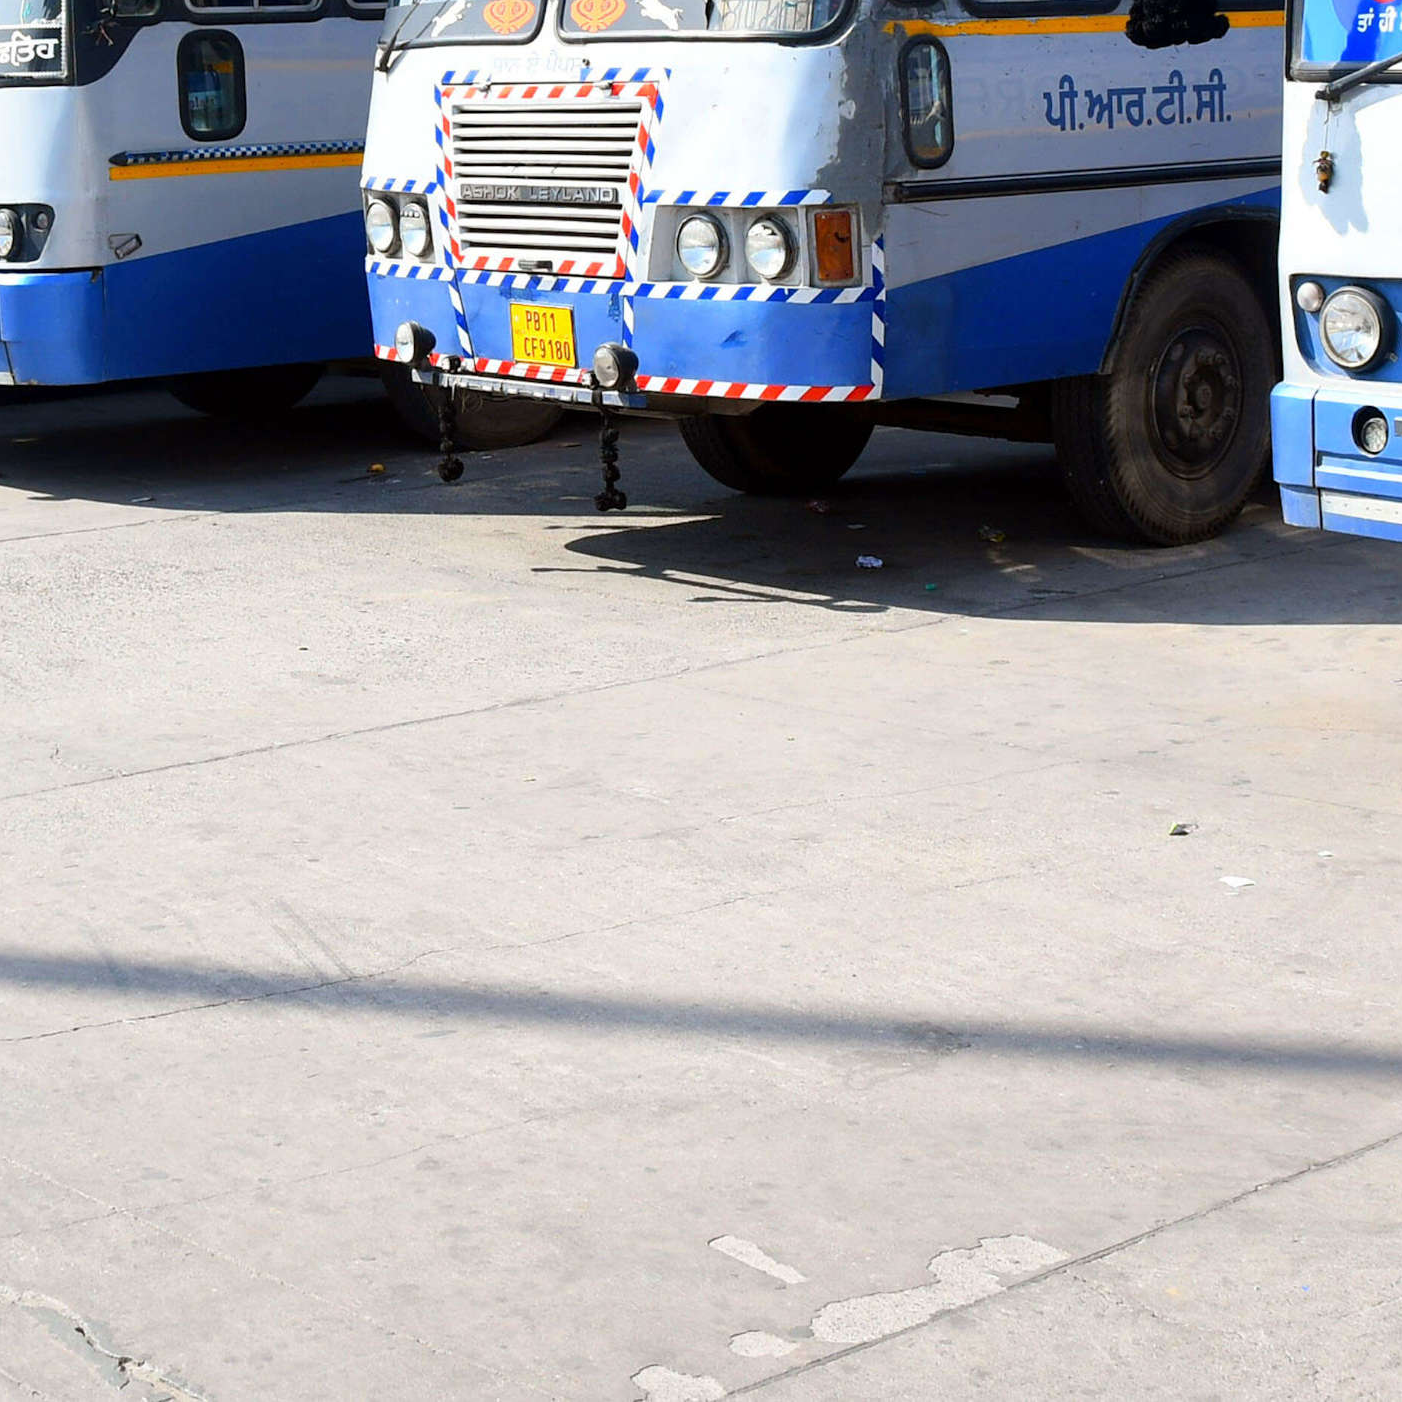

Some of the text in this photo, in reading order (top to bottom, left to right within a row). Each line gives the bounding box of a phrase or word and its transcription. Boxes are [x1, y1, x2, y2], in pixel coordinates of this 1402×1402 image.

[1043, 68, 1232, 132] ਪੀ.ਆਰ.ਟੀ.ਸੀ.
[461, 184, 615, 203] ASHOK LEYLAND
[525, 309, 556, 333] PB11
[523, 337, 571, 362] CF9180
